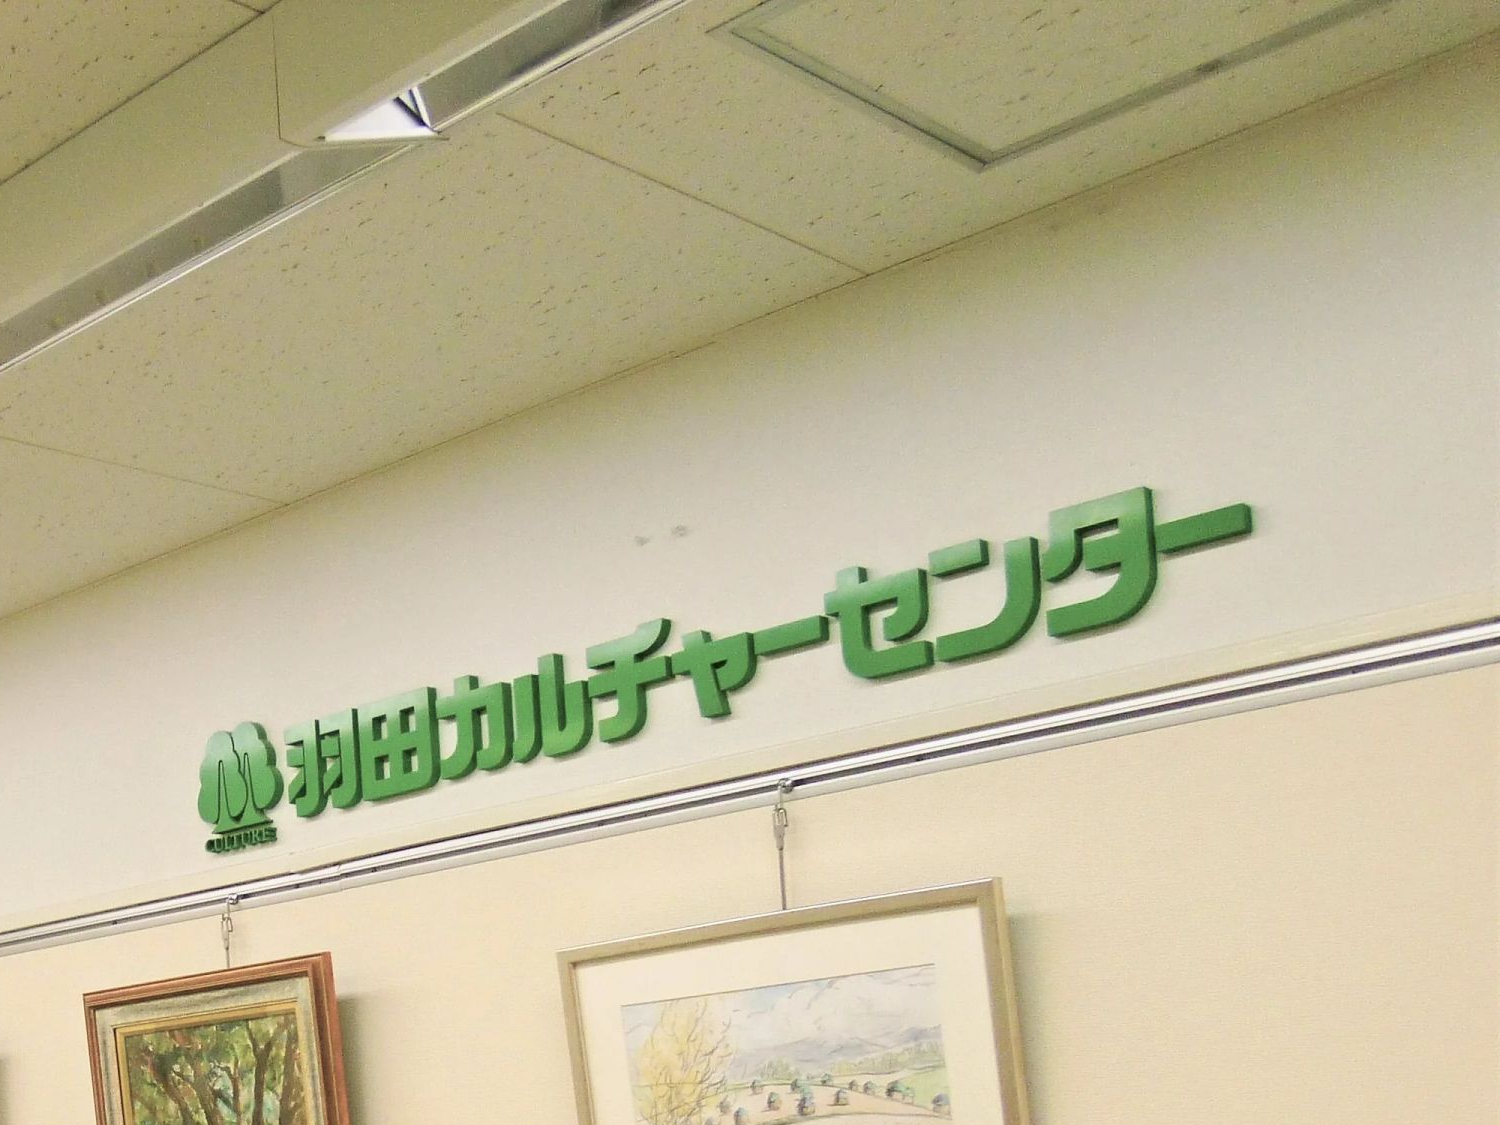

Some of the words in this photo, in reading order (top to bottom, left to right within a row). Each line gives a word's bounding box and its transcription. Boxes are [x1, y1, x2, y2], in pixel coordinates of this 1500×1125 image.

[286, 486, 1252, 818] 羽田カルチャーセンター
[206, 827, 277, 853] CULTURE
